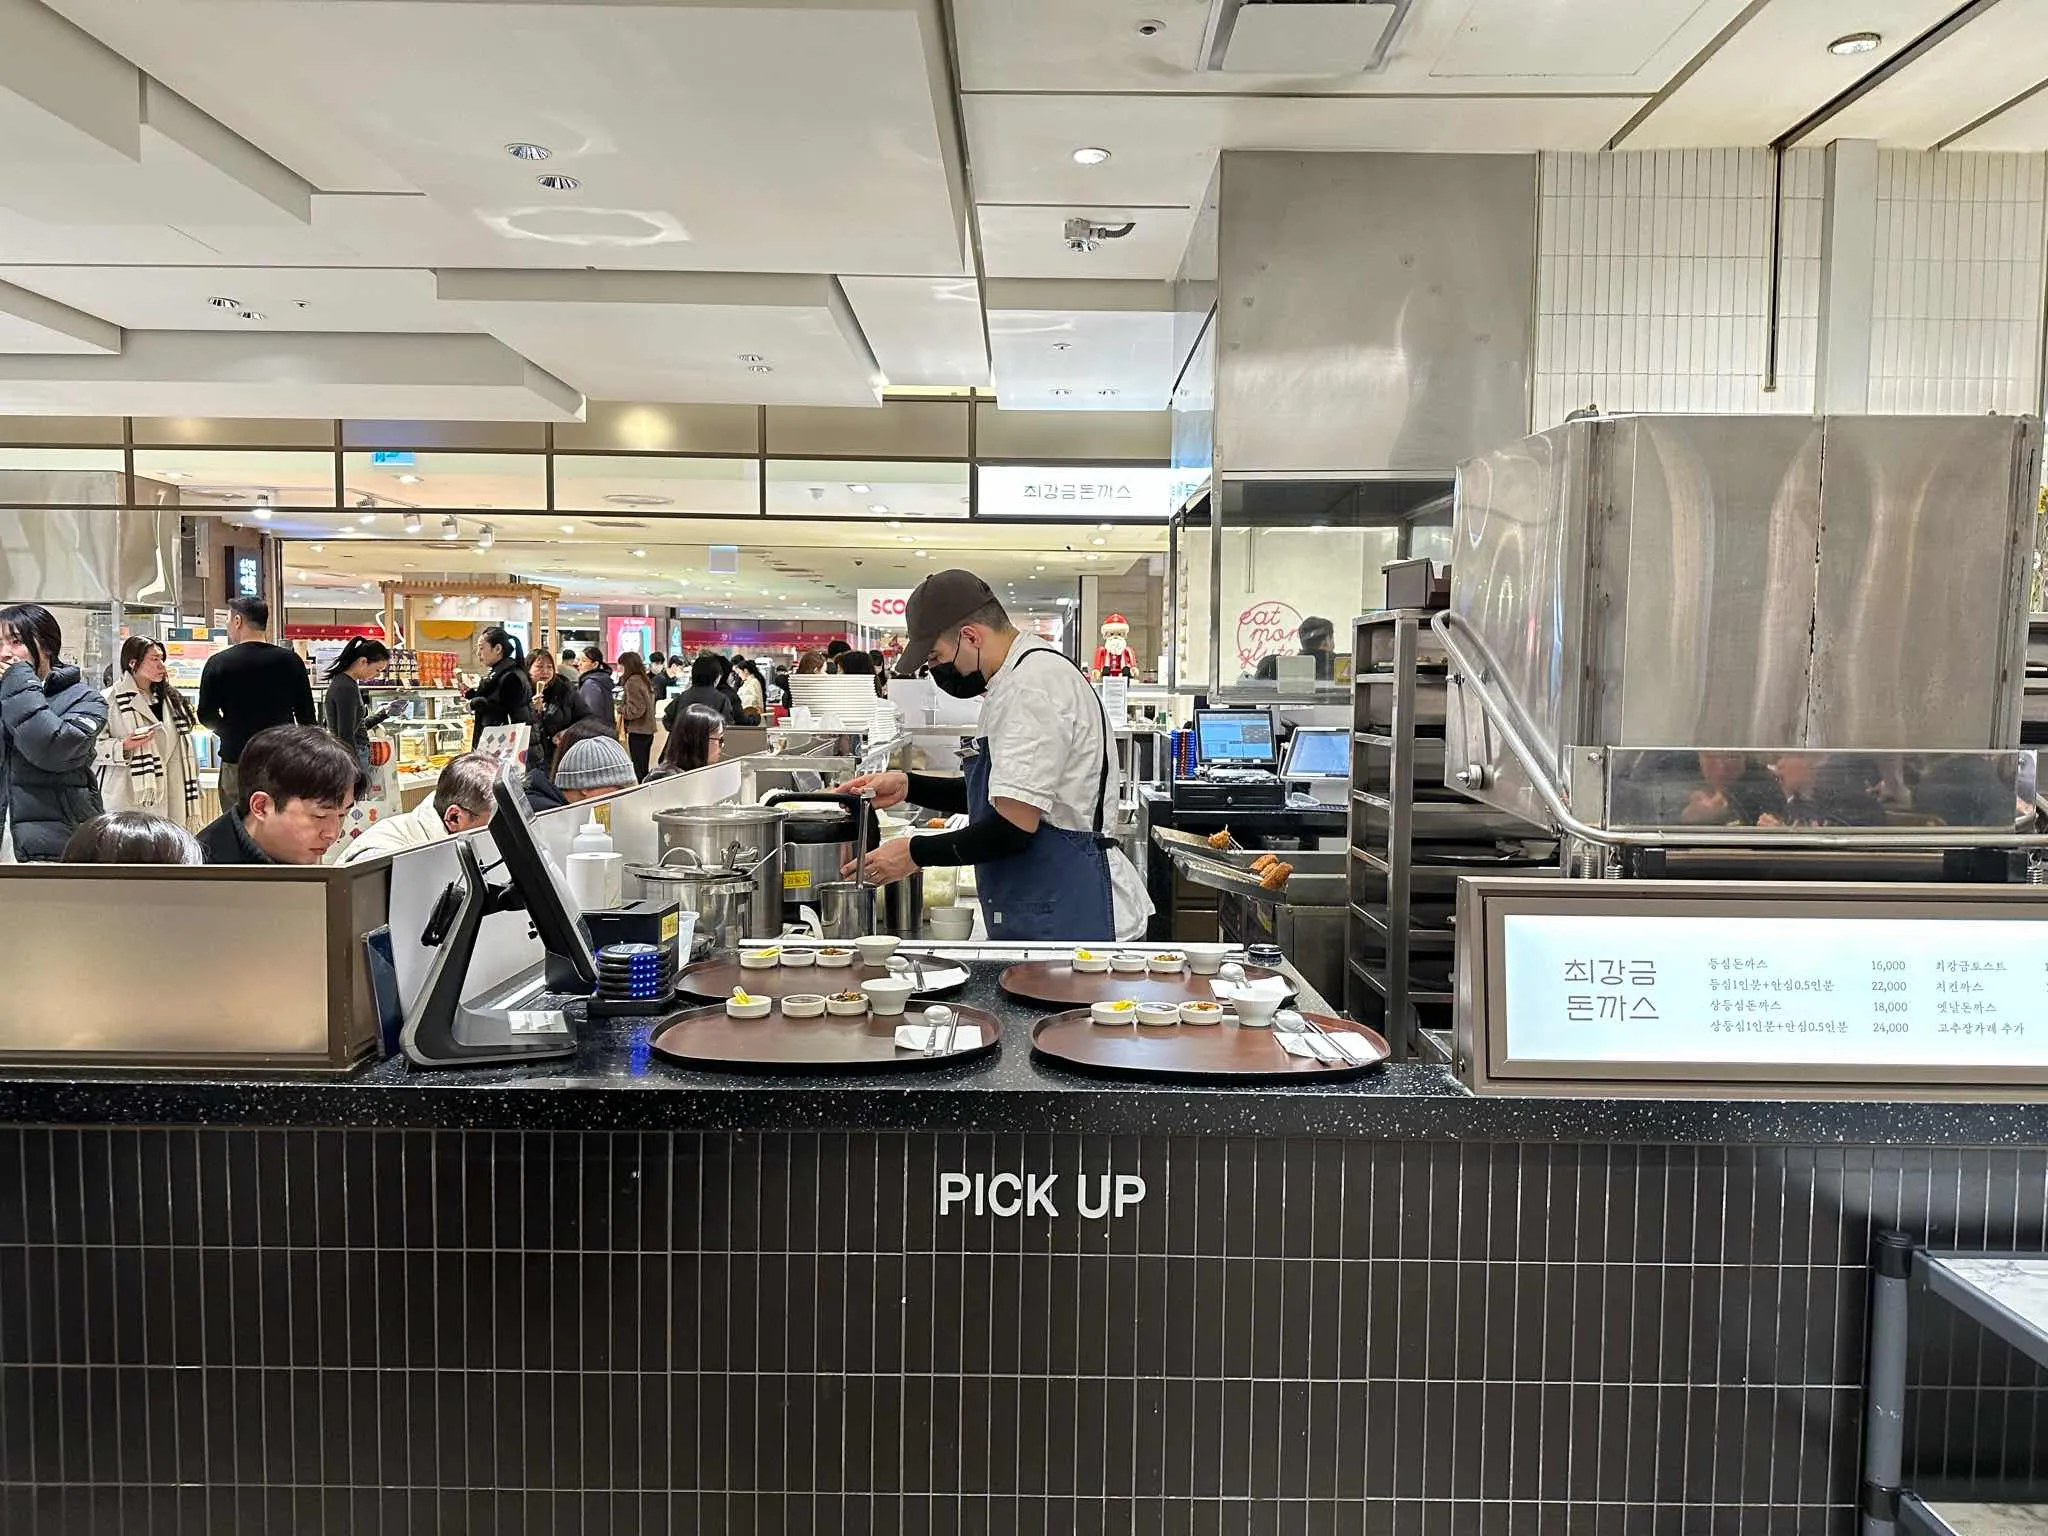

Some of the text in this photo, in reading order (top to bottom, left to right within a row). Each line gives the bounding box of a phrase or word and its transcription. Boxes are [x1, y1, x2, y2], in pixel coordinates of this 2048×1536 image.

[1023, 483, 1132, 500] 최강금돈까스
[870, 598, 906, 615] SCO
[1240, 606, 1281, 625] eat
[1249, 627, 1300, 641] mor
[1708, 957, 1906, 972] 등심돈까스 16,000
[1936, 959, 2008, 973] 최강금토스트
[1564, 959, 1657, 985] 최강금
[1871, 980, 1907, 993] 22,000
[1936, 980, 1984, 993] 치킨까스
[1566, 995, 1660, 1021] 돈까스
[1710, 999, 1908, 1013] 상등심돈까스 18,000
[1937, 1001, 1997, 1014] 옛날돈까스
[1873, 1022, 1909, 1035] 24,000
[1938, 1022, 2025, 1036] 고추장카레 추가
[940, 1172, 1147, 1219] PICK UP
